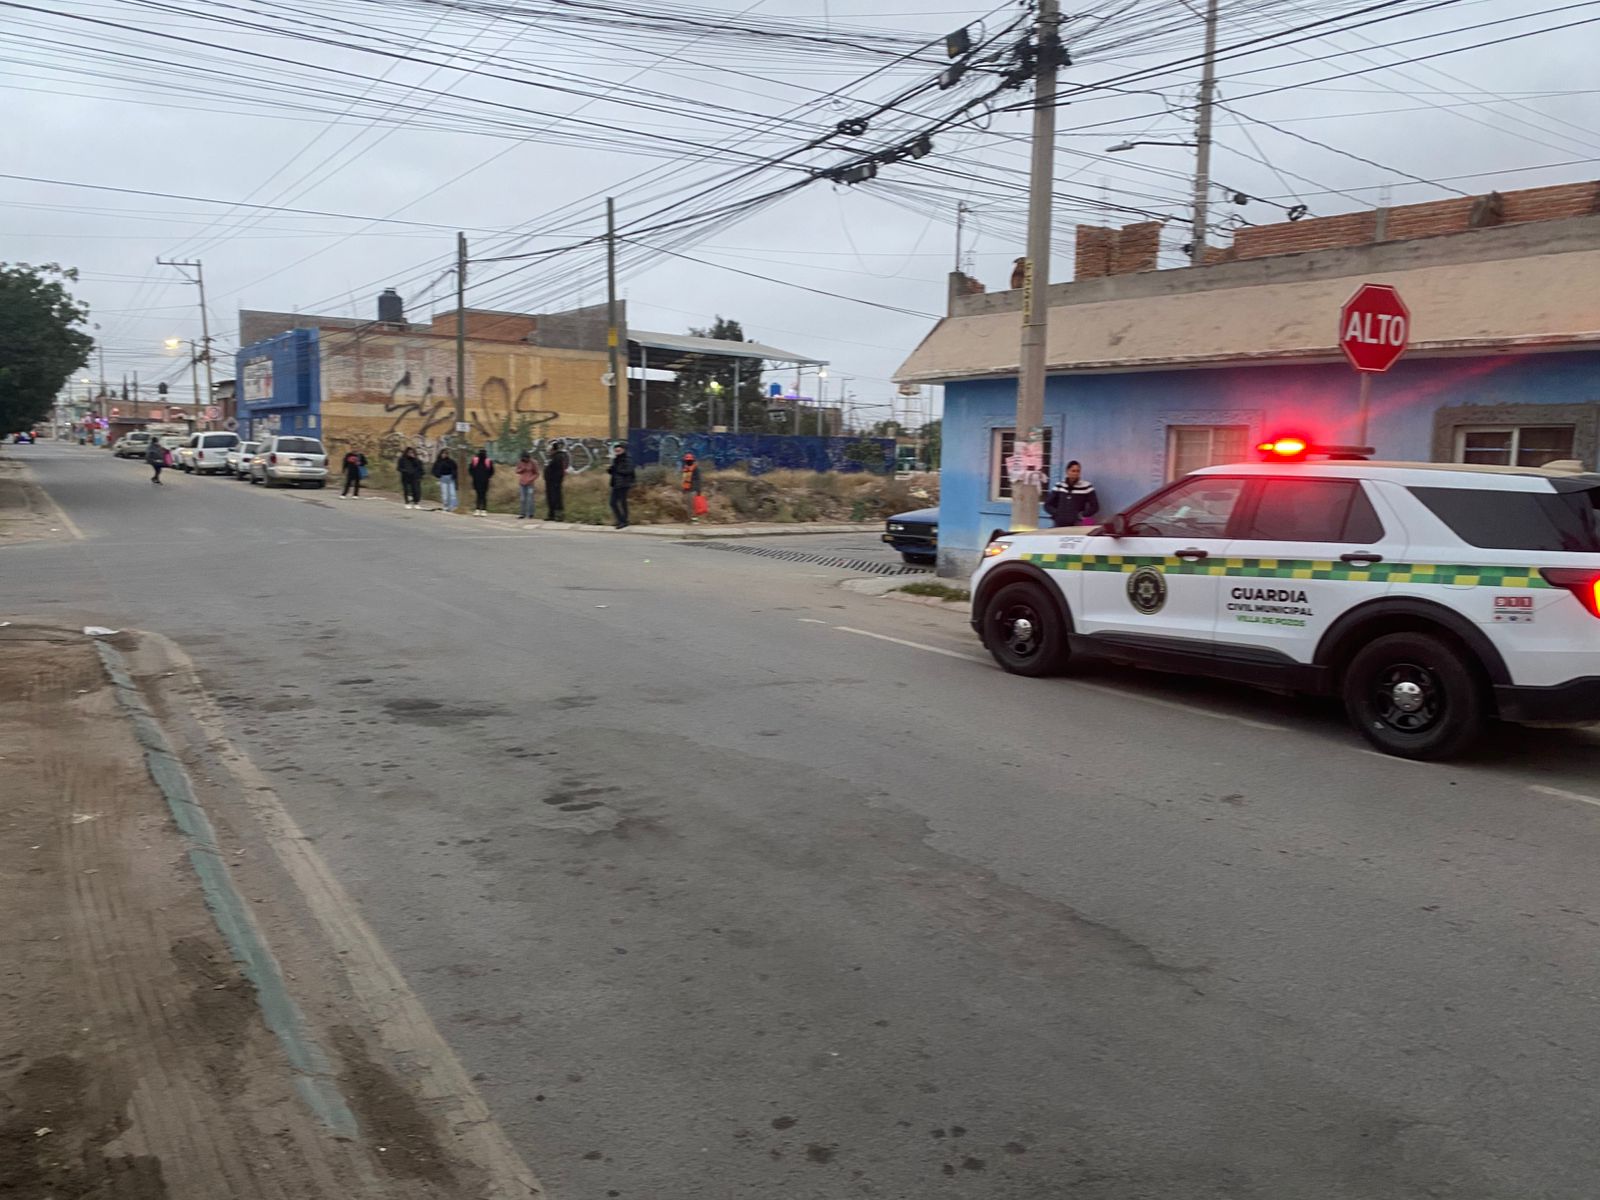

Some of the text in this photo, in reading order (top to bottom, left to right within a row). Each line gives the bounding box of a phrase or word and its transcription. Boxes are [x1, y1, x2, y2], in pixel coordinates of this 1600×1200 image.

[1344, 311, 1405, 347] ALTO
[1231, 587, 1308, 603] GUARDIA
[1227, 603, 1314, 616] CIVIL MUNICIPAL
